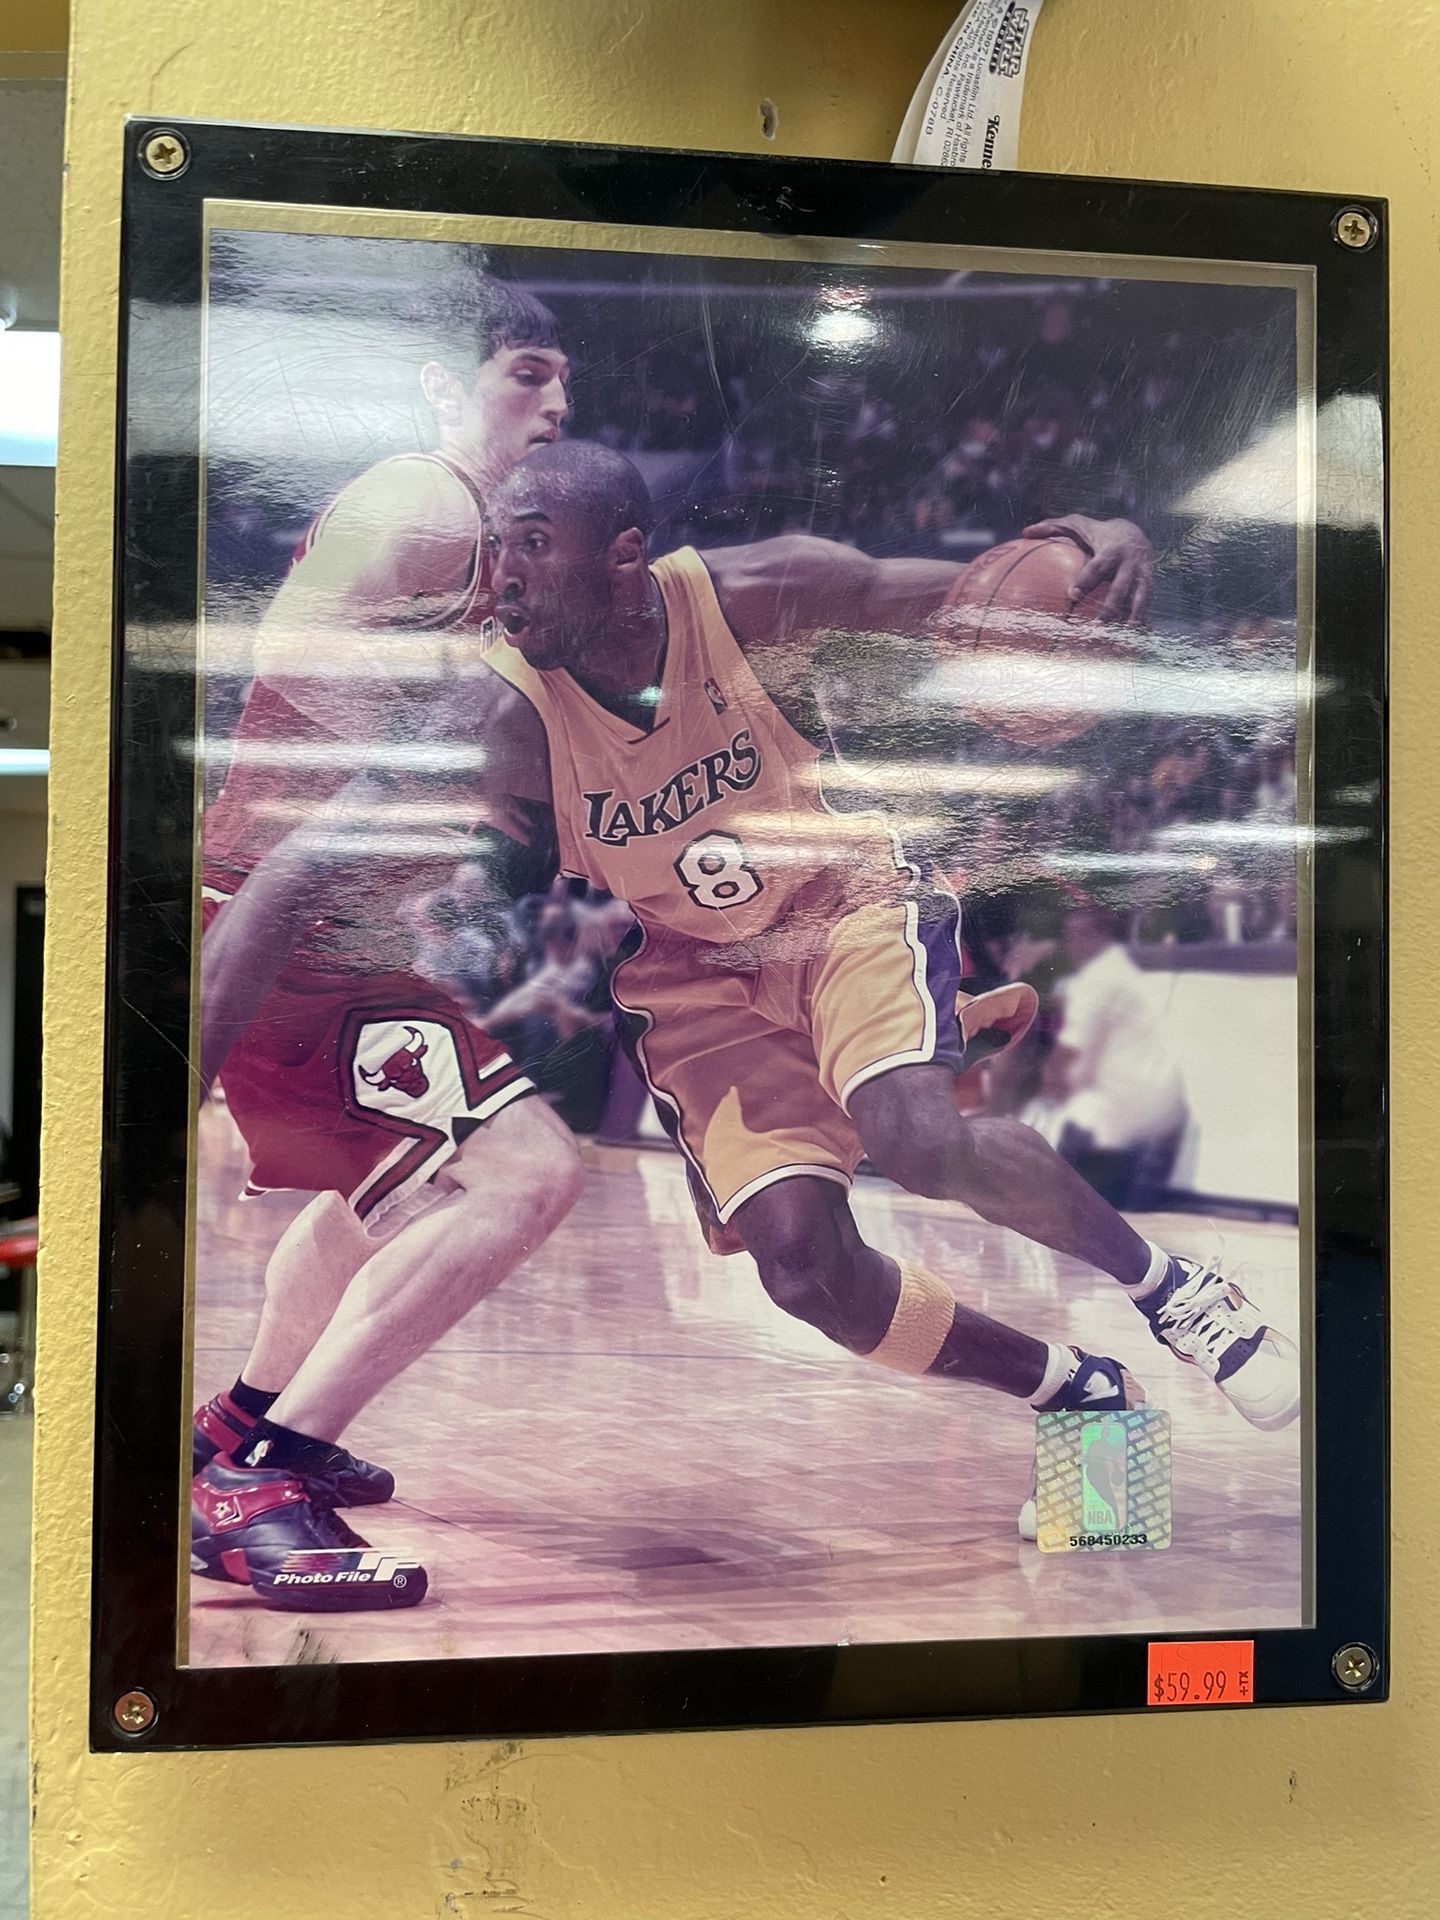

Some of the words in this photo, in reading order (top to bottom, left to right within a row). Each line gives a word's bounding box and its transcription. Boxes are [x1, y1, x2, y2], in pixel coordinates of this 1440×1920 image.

[941, 36, 964, 79] CHINA.
[970, 56, 986, 101] Lucasfilm
[946, 73, 966, 123] Pawtucket,
[957, 71, 973, 119] trademark
[959, 137, 970, 163] rights
[963, 122, 972, 136] All
[981, 114, 1000, 169] Kenne
[582, 728, 762, 847] LAKERS
[672, 828, 765, 911] 8
[1087, 1510, 1113, 1525] NBA
[273, 1573, 334, 1585] Photo
[334, 1571, 372, 1583] File
[1154, 1670, 1227, 1702] $59.99
[1238, 1670, 1249, 1696] +TX
